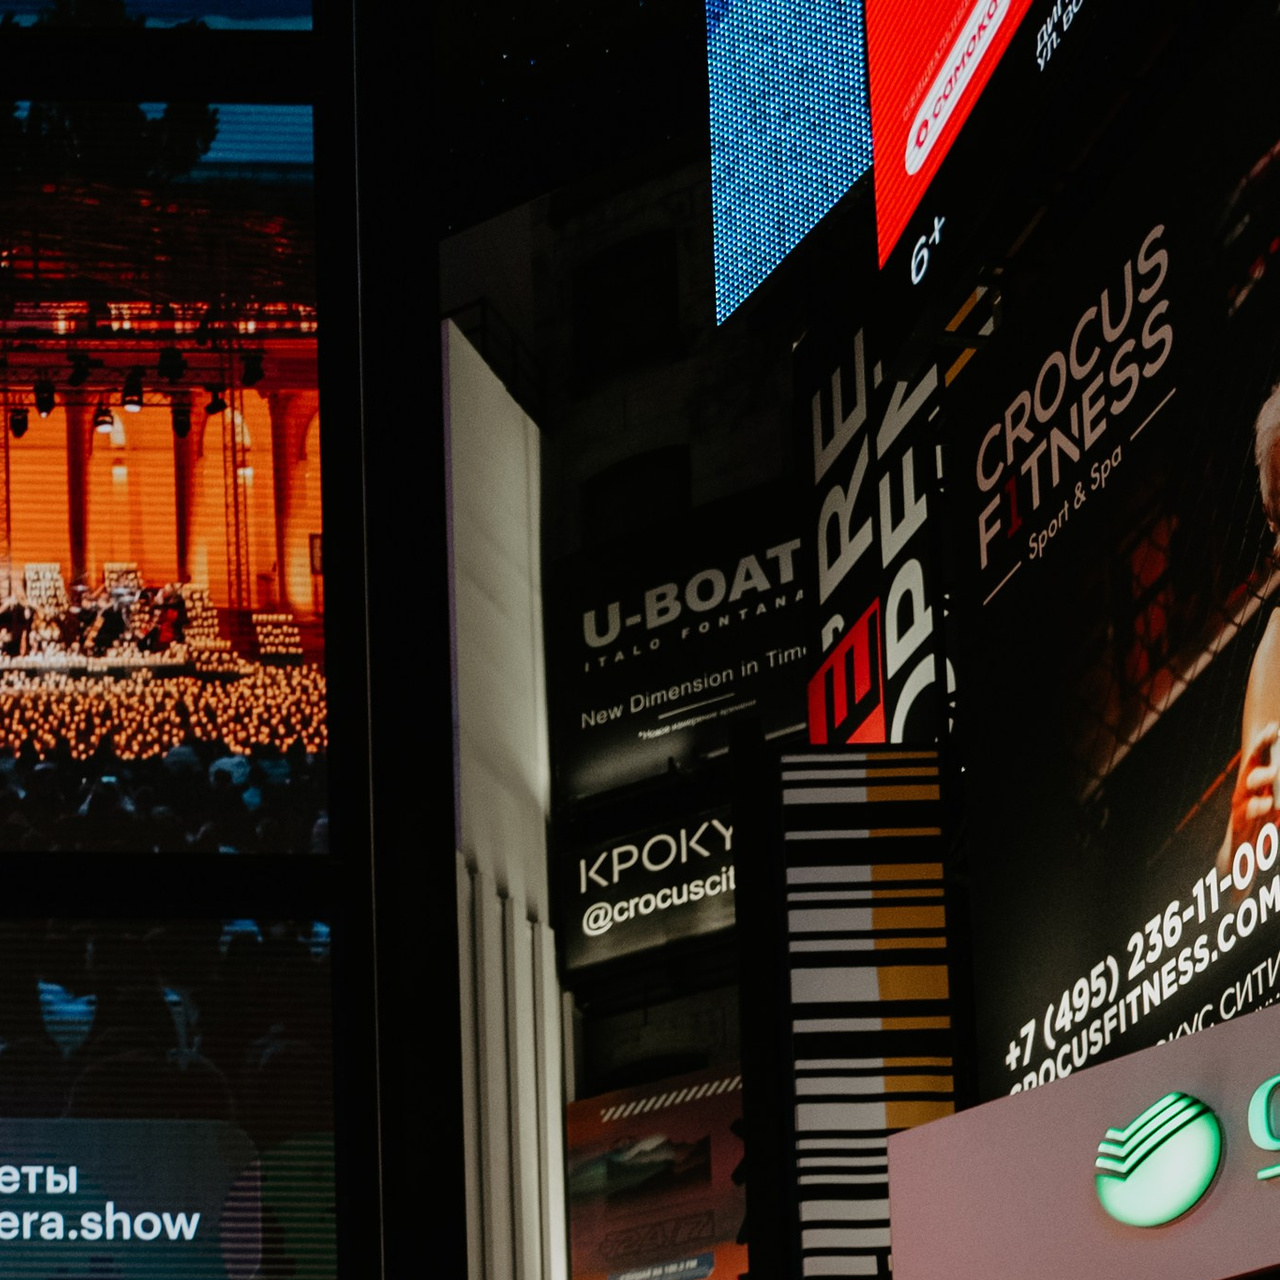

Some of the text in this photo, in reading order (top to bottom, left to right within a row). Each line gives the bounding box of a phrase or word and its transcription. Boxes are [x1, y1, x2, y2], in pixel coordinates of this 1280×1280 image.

[910, 216, 946, 285] 6+
[976, 223, 1169, 492] CROCUS
[1028, 445, 1122, 560] Sport & Spa
[582, 538, 802, 648] U-BOAT
[584, 589, 805, 673] ITALO FONTANA
[581, 646, 808, 729] New Dimension in Tim
[1005, 822, 1279, 1072] +7 (495) 236-11-00
